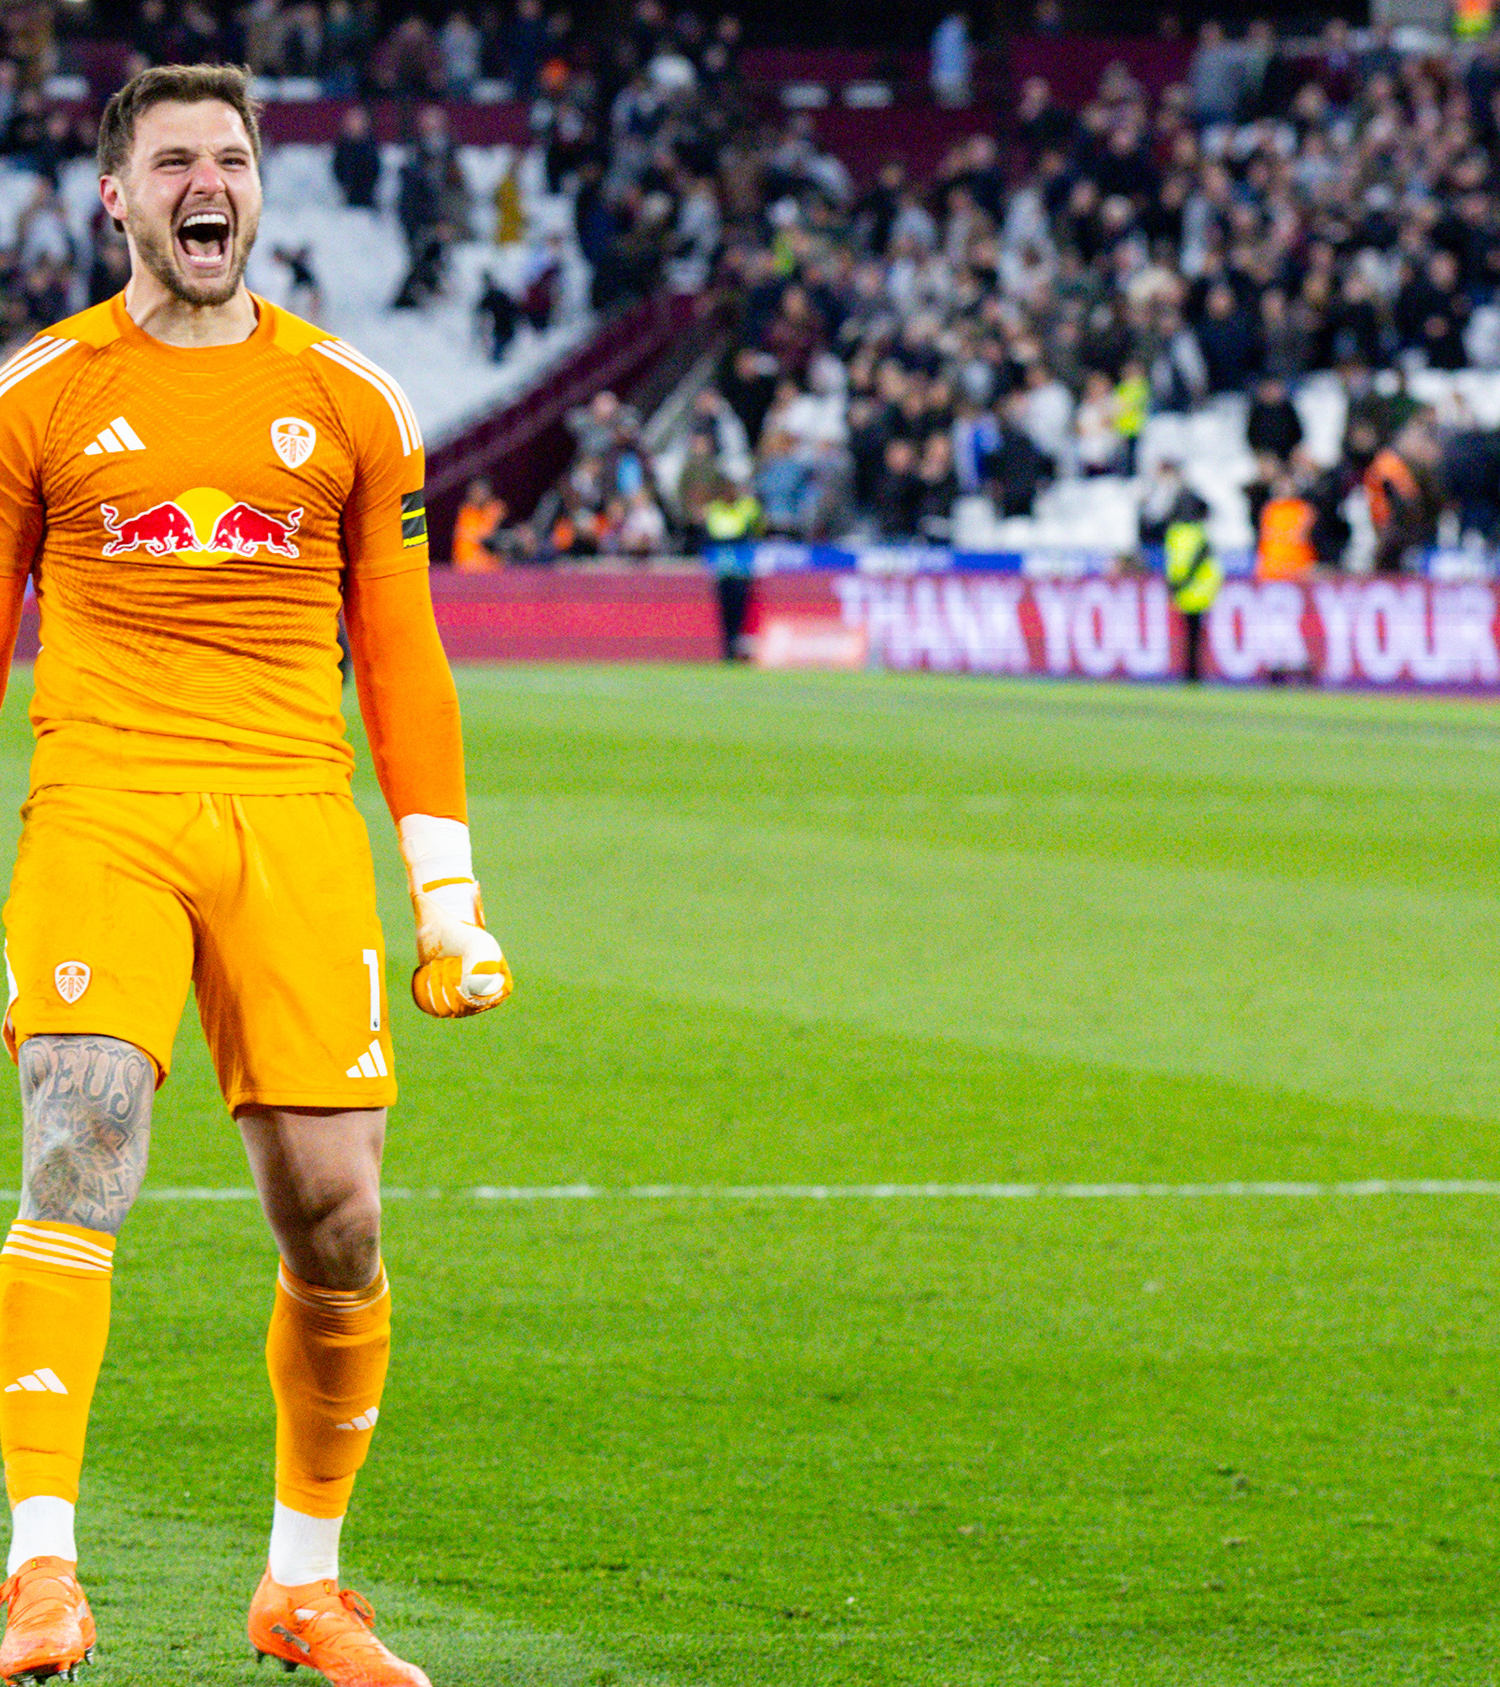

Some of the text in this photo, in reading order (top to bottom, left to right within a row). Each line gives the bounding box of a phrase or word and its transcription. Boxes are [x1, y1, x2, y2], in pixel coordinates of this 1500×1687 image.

[834, 572, 1031, 674] THANK
[1030, 574, 1170, 678] YOU
[1209, 580, 1308, 680] OR
[1313, 578, 1499, 682] YOUR
[362, 948, 381, 1032] 1
